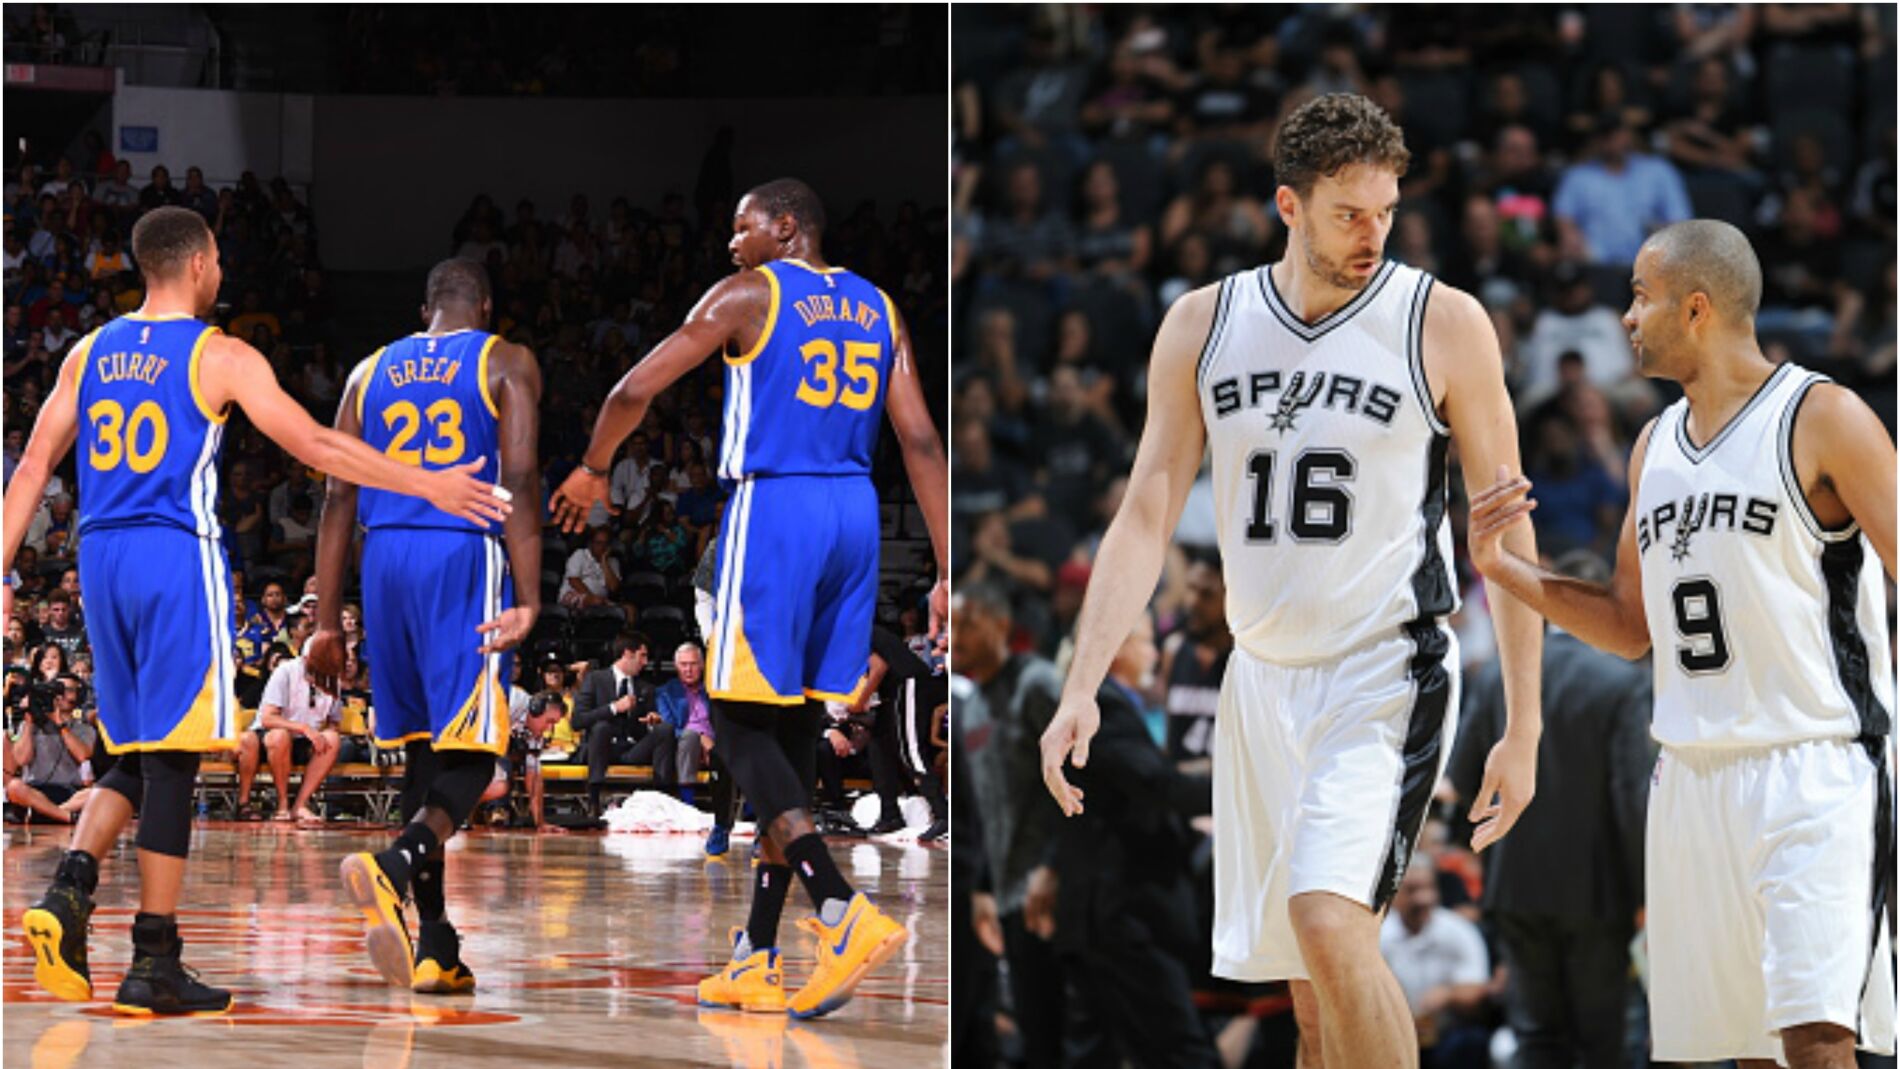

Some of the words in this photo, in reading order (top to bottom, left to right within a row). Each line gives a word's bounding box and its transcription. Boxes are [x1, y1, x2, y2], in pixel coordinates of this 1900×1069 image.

[793, 294, 881, 332] DURANT
[97, 352, 168, 385] CURRY
[387, 357, 461, 388] GREEN
[795, 337, 881, 411] 35
[1212, 371, 1402, 434] SPURS
[88, 400, 169, 473] 30
[381, 398, 466, 465] 23
[1245, 447, 1358, 545] 16
[1638, 492, 1778, 561] SPURS
[1670, 574, 1734, 678] 9
